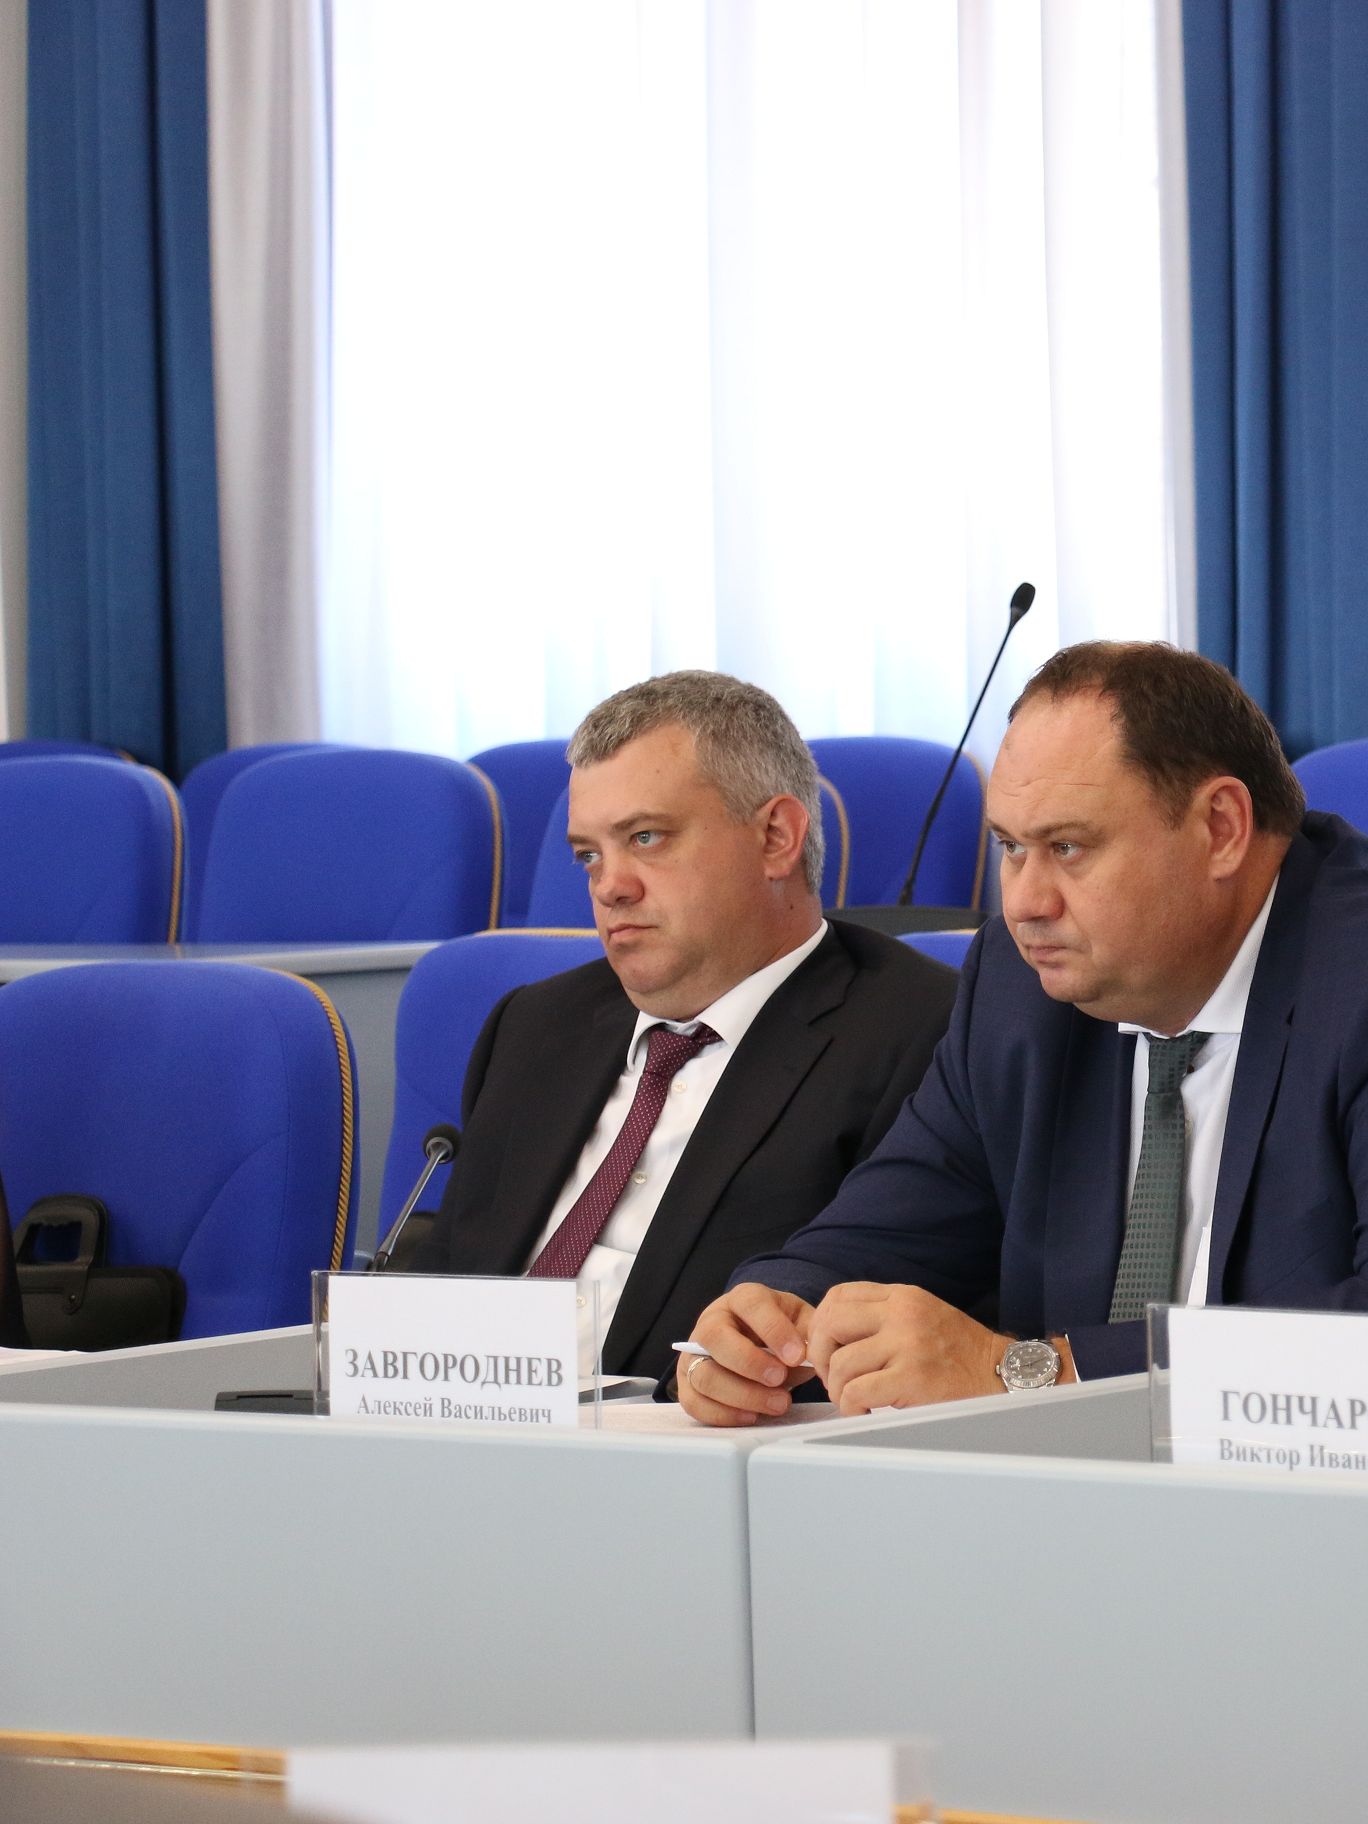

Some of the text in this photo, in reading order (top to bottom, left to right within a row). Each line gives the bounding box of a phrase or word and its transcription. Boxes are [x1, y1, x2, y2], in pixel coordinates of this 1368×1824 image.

[344, 1348, 564, 1391] ЗАВГОРОДНЕВ
[356, 1393, 553, 1424] Алексей Васильевич
[1219, 1438, 1301, 1471] Виктор
